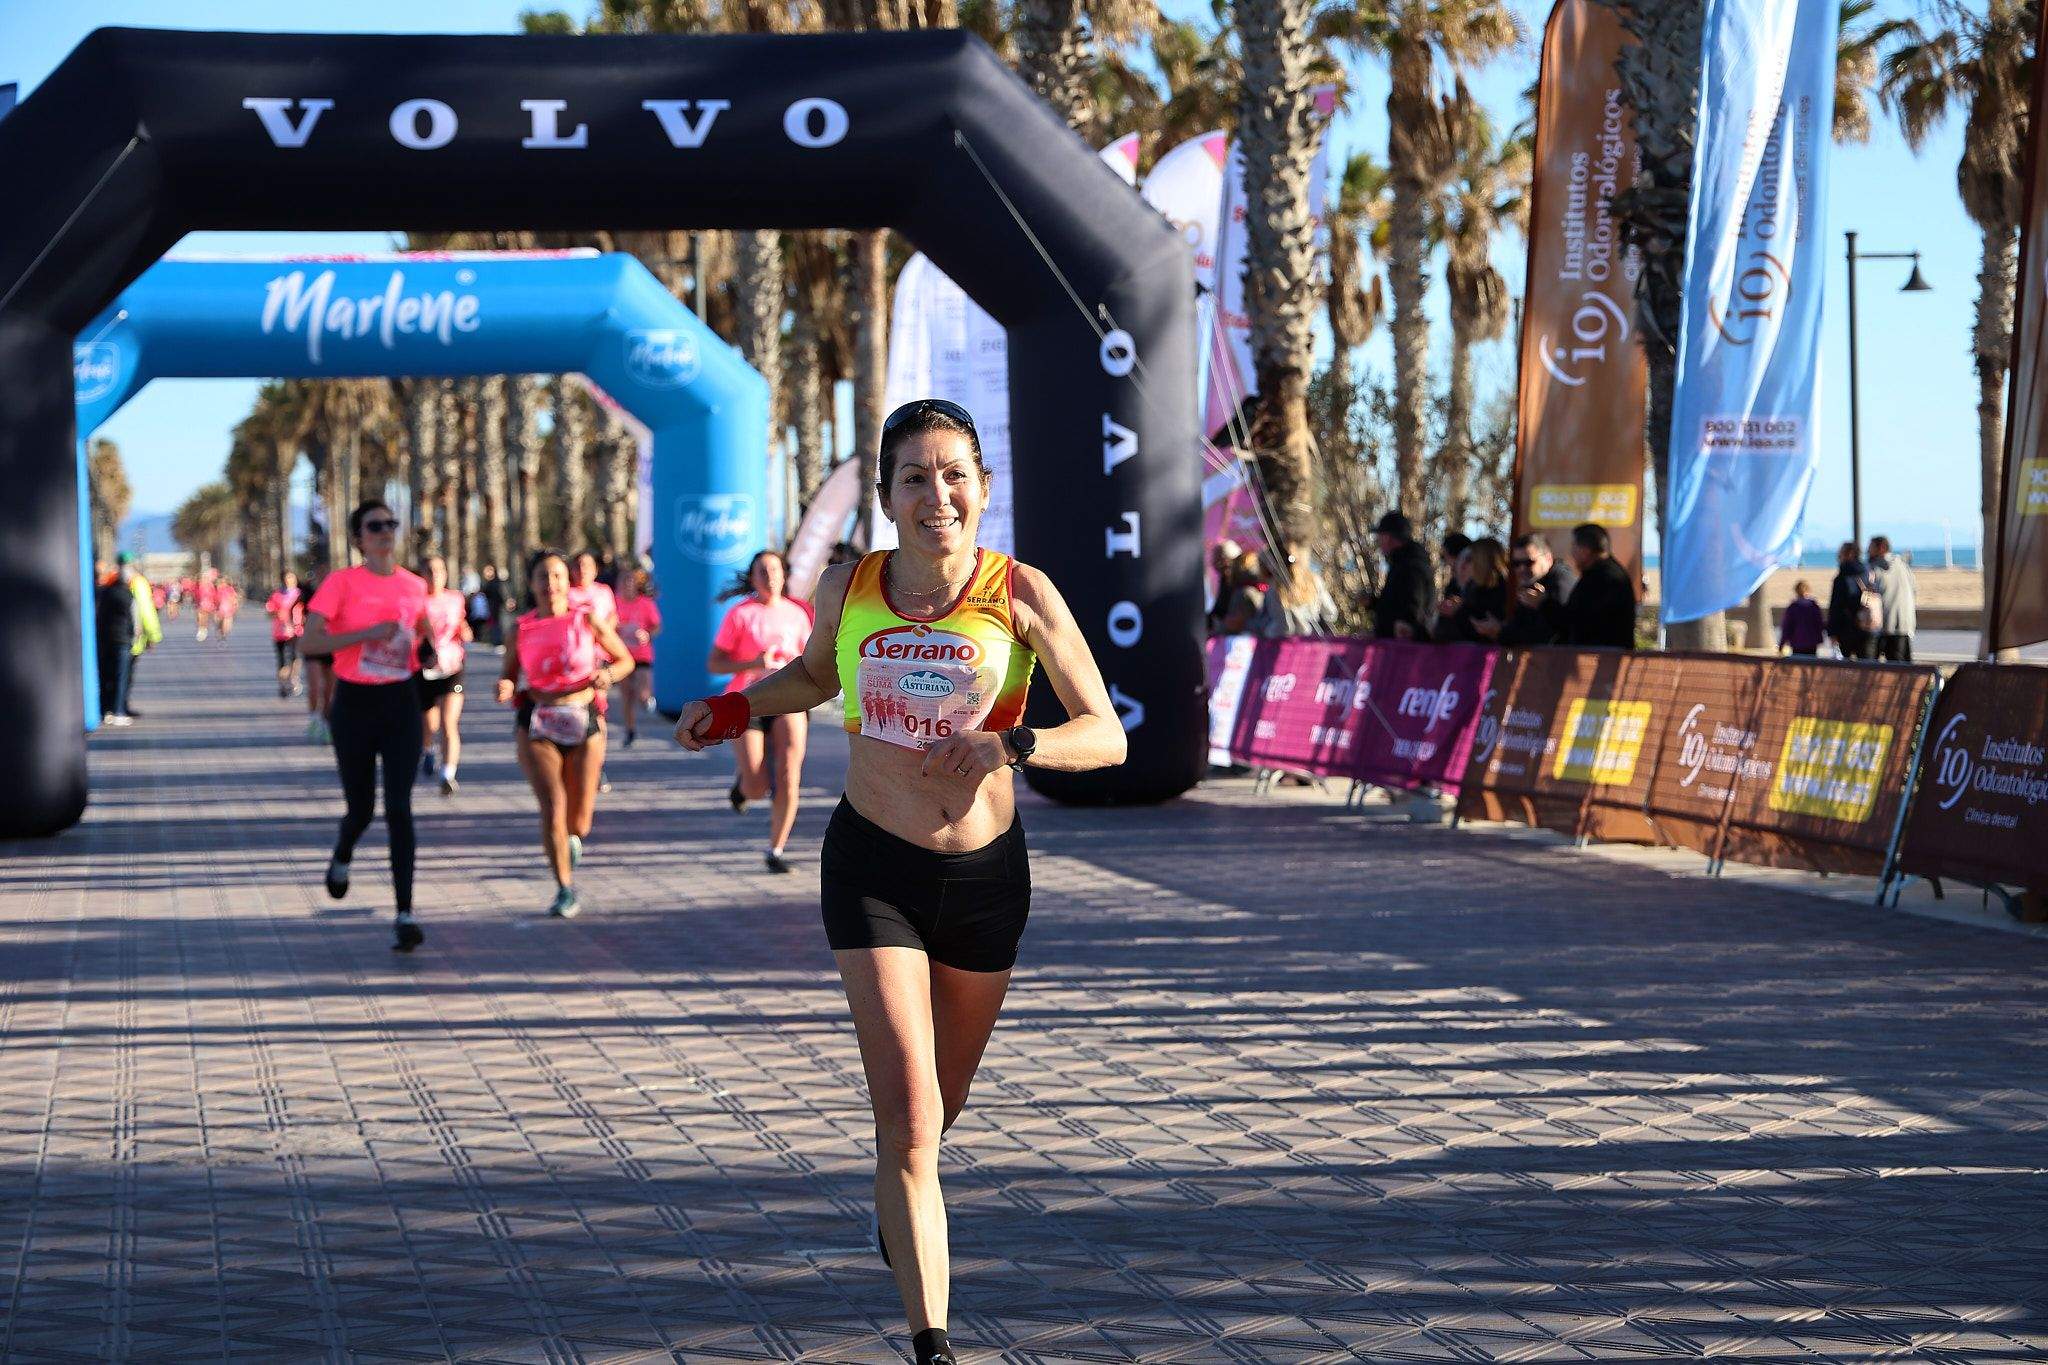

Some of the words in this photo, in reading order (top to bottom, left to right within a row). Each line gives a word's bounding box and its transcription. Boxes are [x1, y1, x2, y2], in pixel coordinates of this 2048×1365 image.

[243, 98, 850, 150] VOLVO
[1559, 151, 1590, 282] Institutos
[261, 269, 480, 365] Marlene
[1100, 328, 1146, 736] VOLVO
[867, 637, 975, 661] Serrano
[867, 680, 893, 689] SUMA
[902, 678, 951, 693] ASTURIANA
[904, 715, 952, 737] 016
